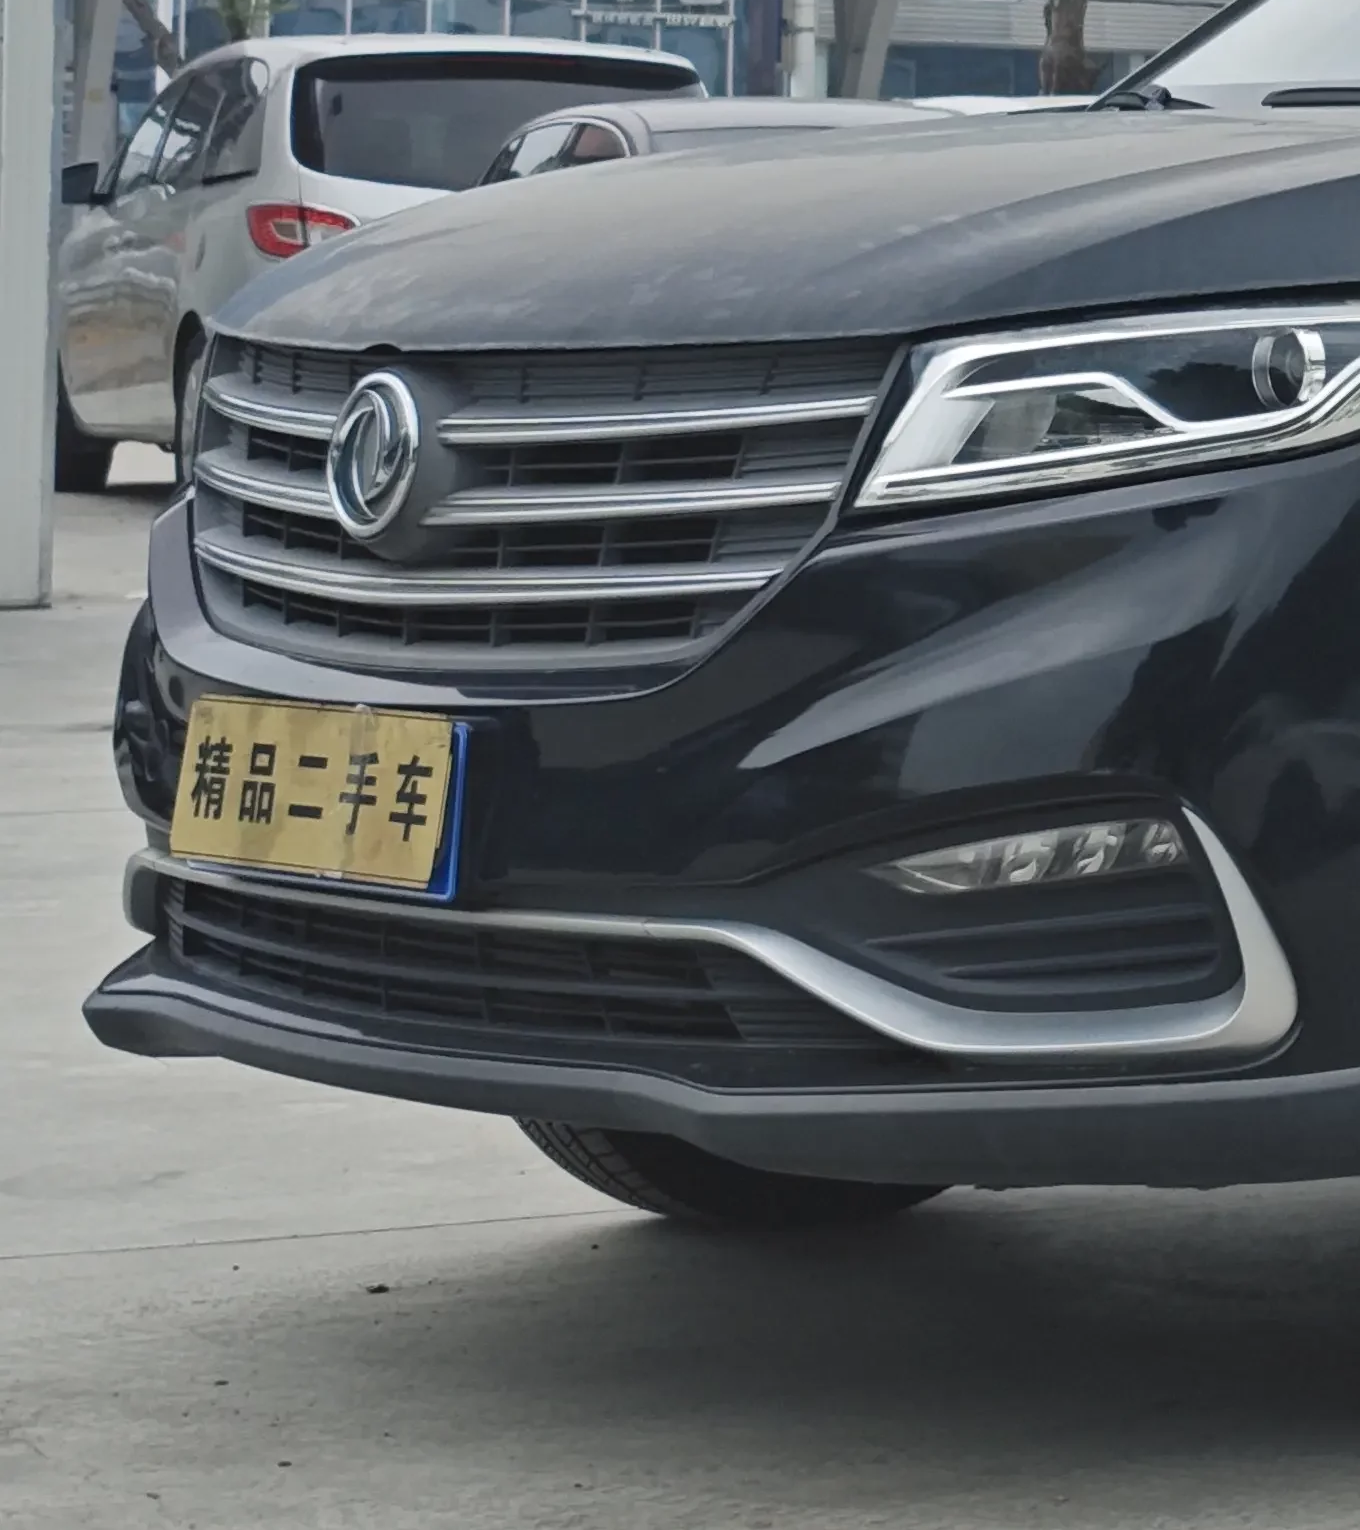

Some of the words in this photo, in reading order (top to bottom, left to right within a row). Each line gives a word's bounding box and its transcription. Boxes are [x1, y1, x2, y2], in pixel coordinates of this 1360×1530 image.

[190, 735, 433, 842] 精品二手车
